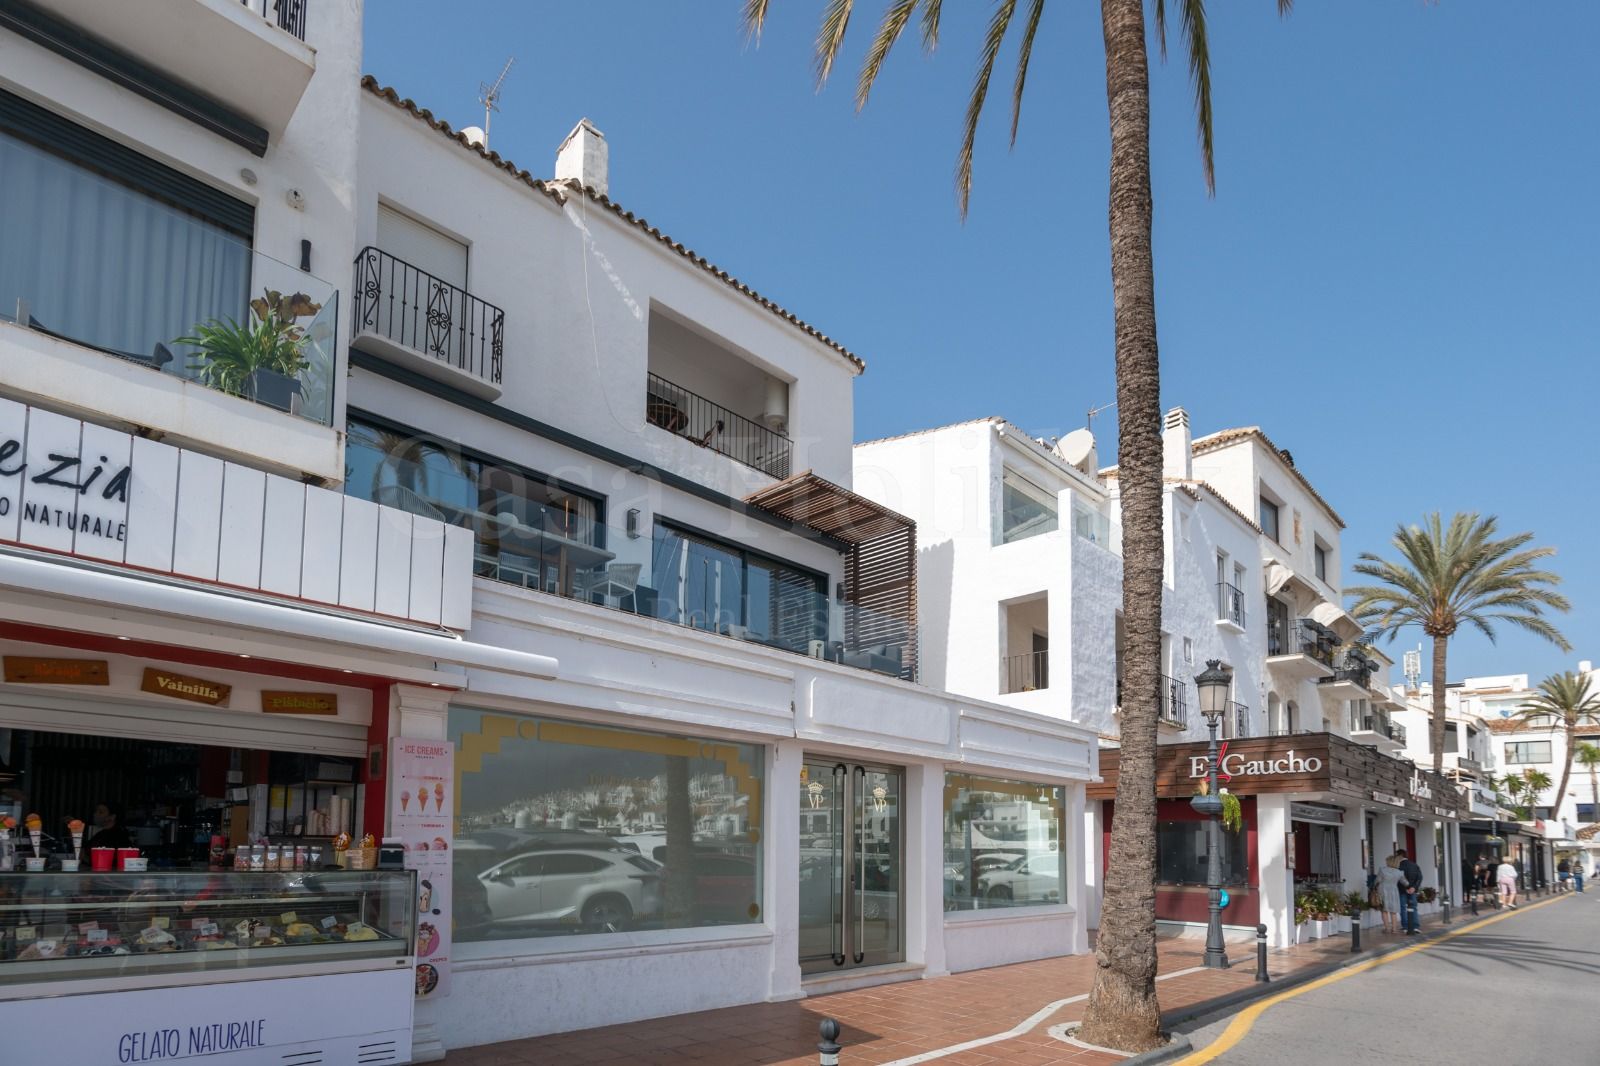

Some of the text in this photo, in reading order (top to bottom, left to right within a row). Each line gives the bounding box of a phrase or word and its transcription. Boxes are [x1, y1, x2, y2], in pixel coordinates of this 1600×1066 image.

[24, 502, 126, 542] NATURALE
[156, 675, 219, 700] Vainilla
[417, 746, 444, 756] CREAMS
[1222, 750, 1322, 777] Gaucho
[119, 1019, 265, 1063] GELATO NATURALE
